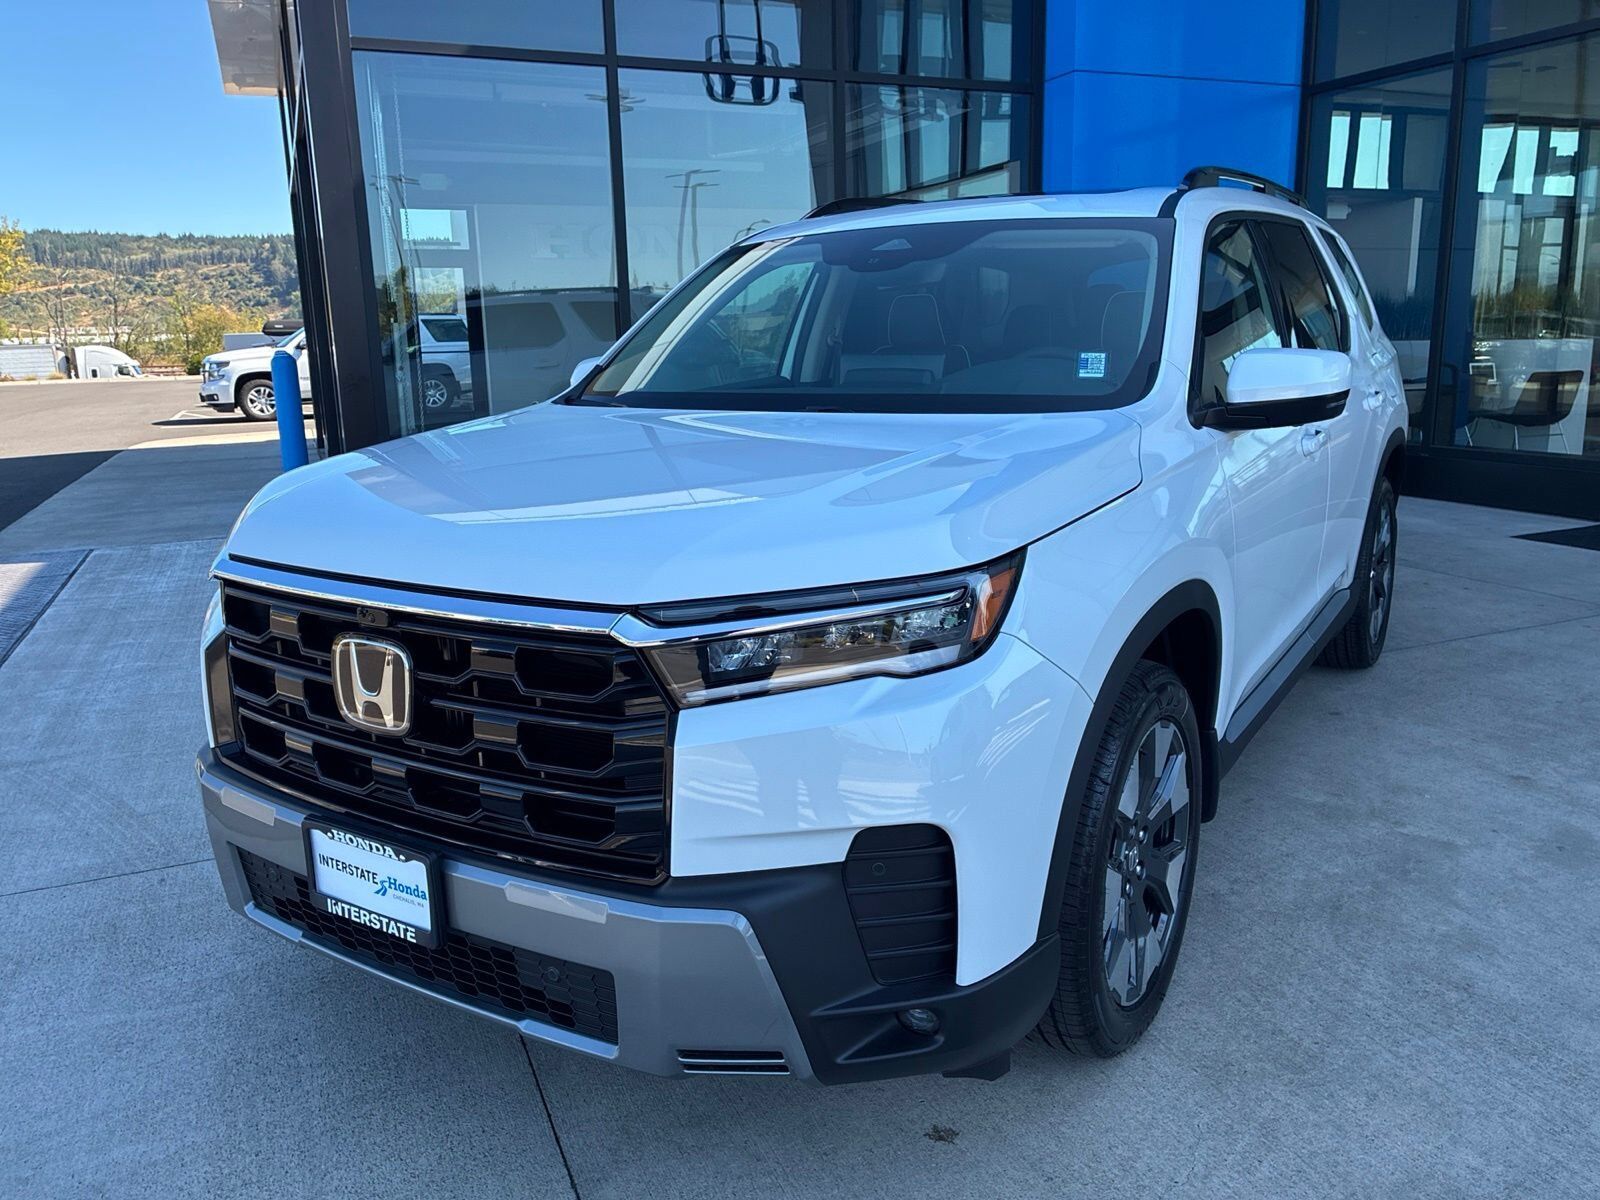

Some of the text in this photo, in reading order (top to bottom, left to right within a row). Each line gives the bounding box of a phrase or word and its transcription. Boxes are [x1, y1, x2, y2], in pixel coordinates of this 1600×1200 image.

[331, 829, 398, 860] HONDA
[318, 852, 428, 901] INTERSTATE Honda
[326, 897, 417, 943] INTERSTATE
